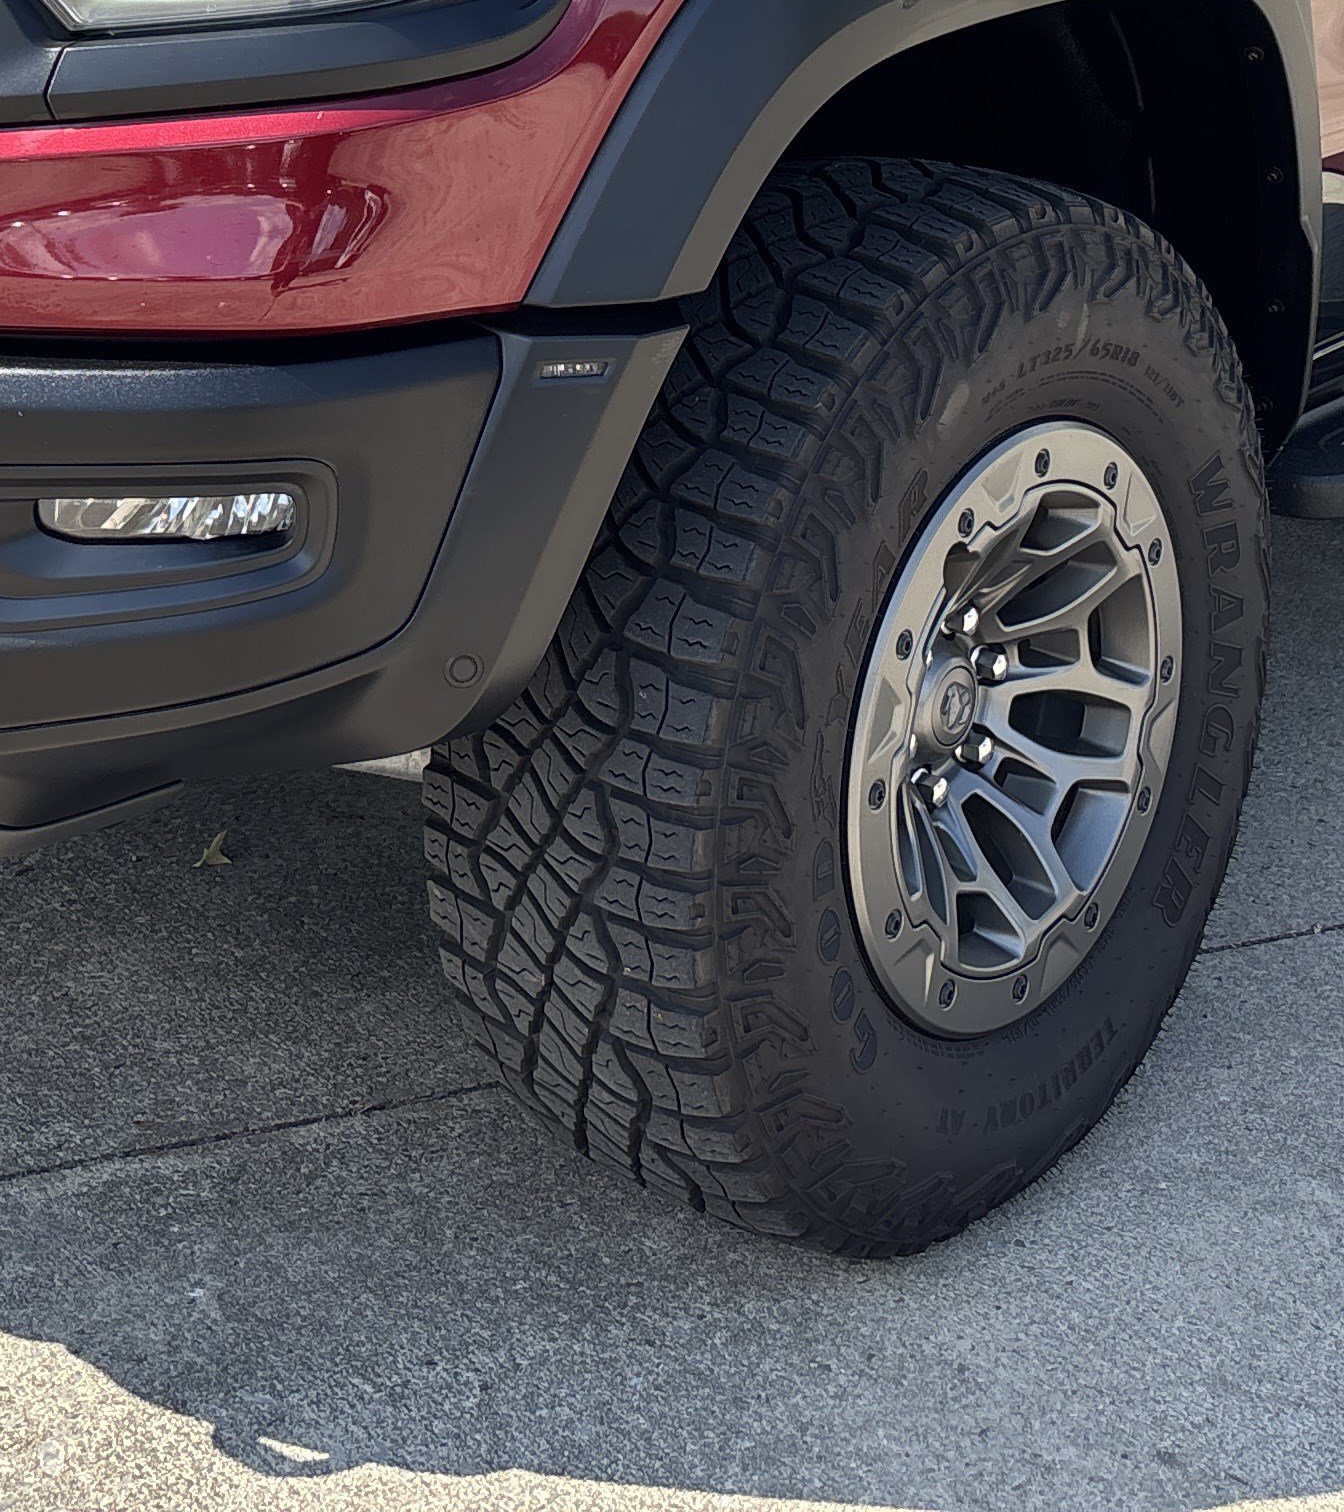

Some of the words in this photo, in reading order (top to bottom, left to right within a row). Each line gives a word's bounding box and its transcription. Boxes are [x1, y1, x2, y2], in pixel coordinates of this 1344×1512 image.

[1016, 336, 1142, 380] LT325/65R18
[1151, 452, 1246, 931] WRANGLER
[982, 1016, 1119, 1137] TERRITORY
[934, 1107, 966, 1136] AT
